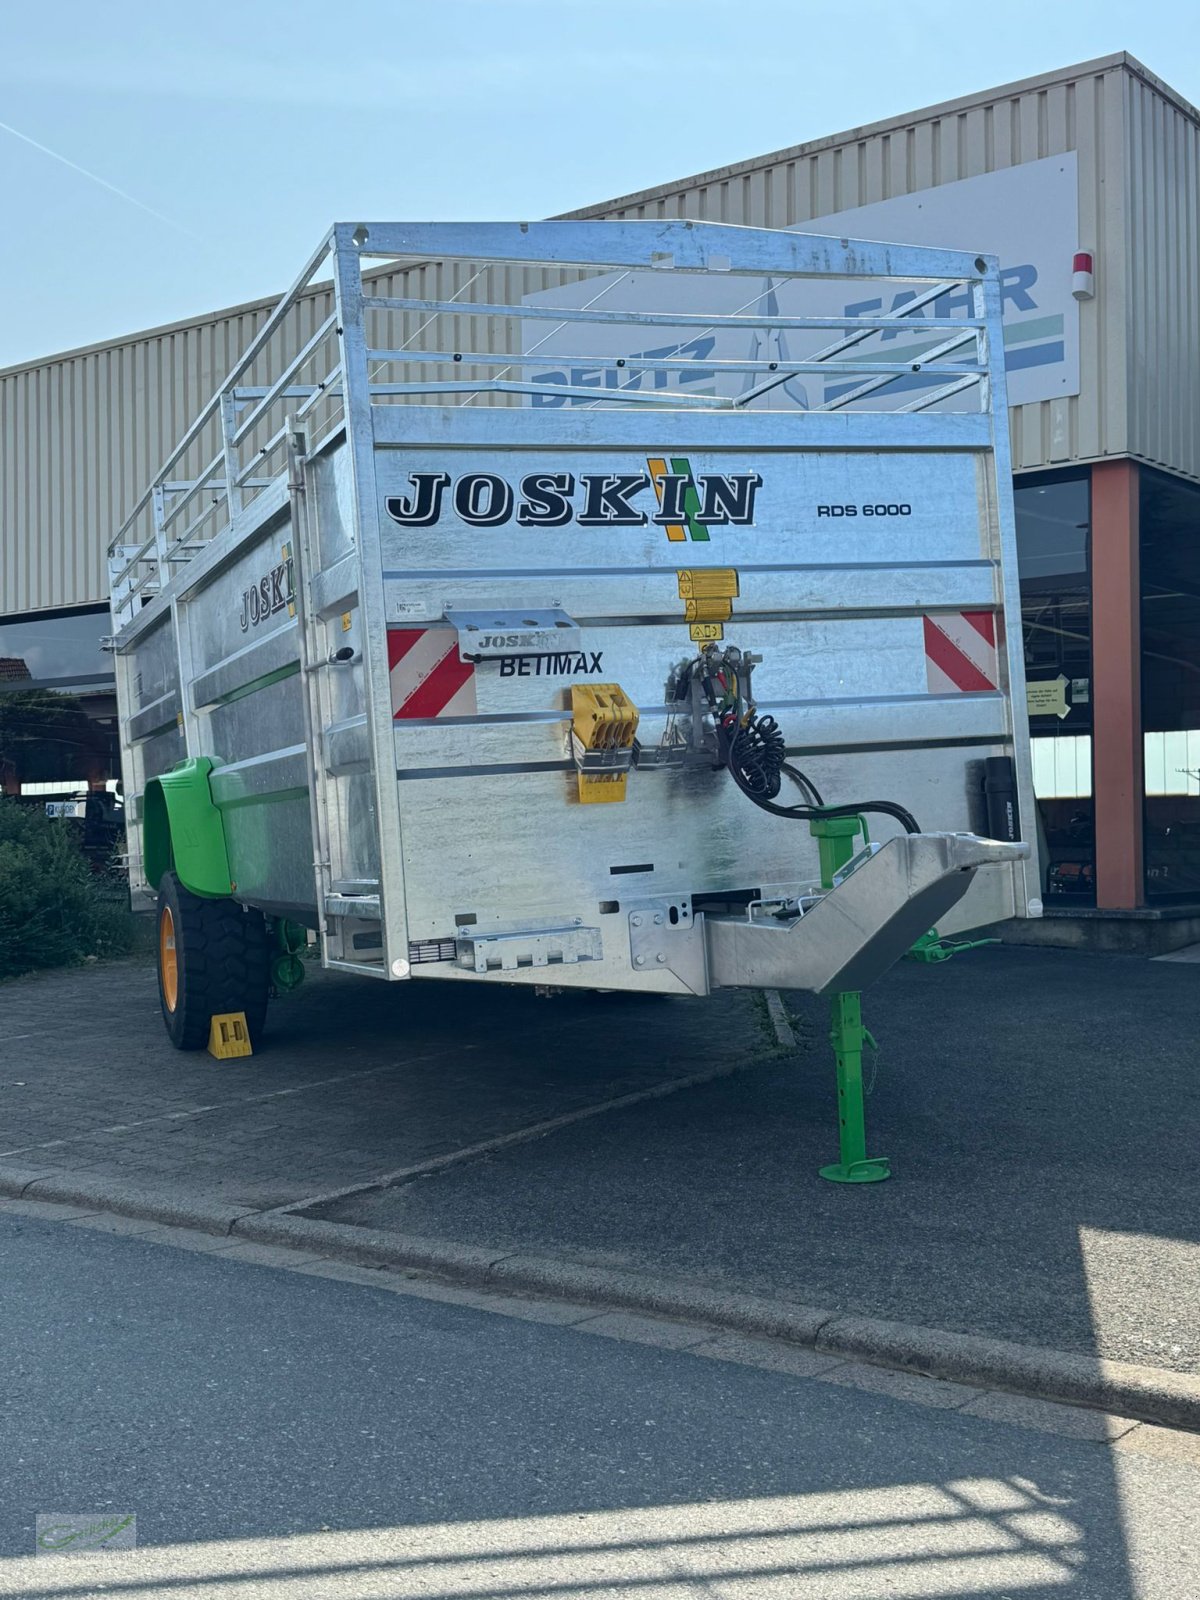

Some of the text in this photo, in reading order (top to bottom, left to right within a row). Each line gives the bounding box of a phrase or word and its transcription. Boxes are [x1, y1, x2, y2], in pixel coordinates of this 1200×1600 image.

[532, 264, 1039, 409] DEUTZ FAHR
[384, 471, 763, 527] JOSKIN
[817, 503, 912, 517] RDS 6000
[240, 556, 295, 633] JOSKI
[500, 650, 604, 677] BETIMAX
